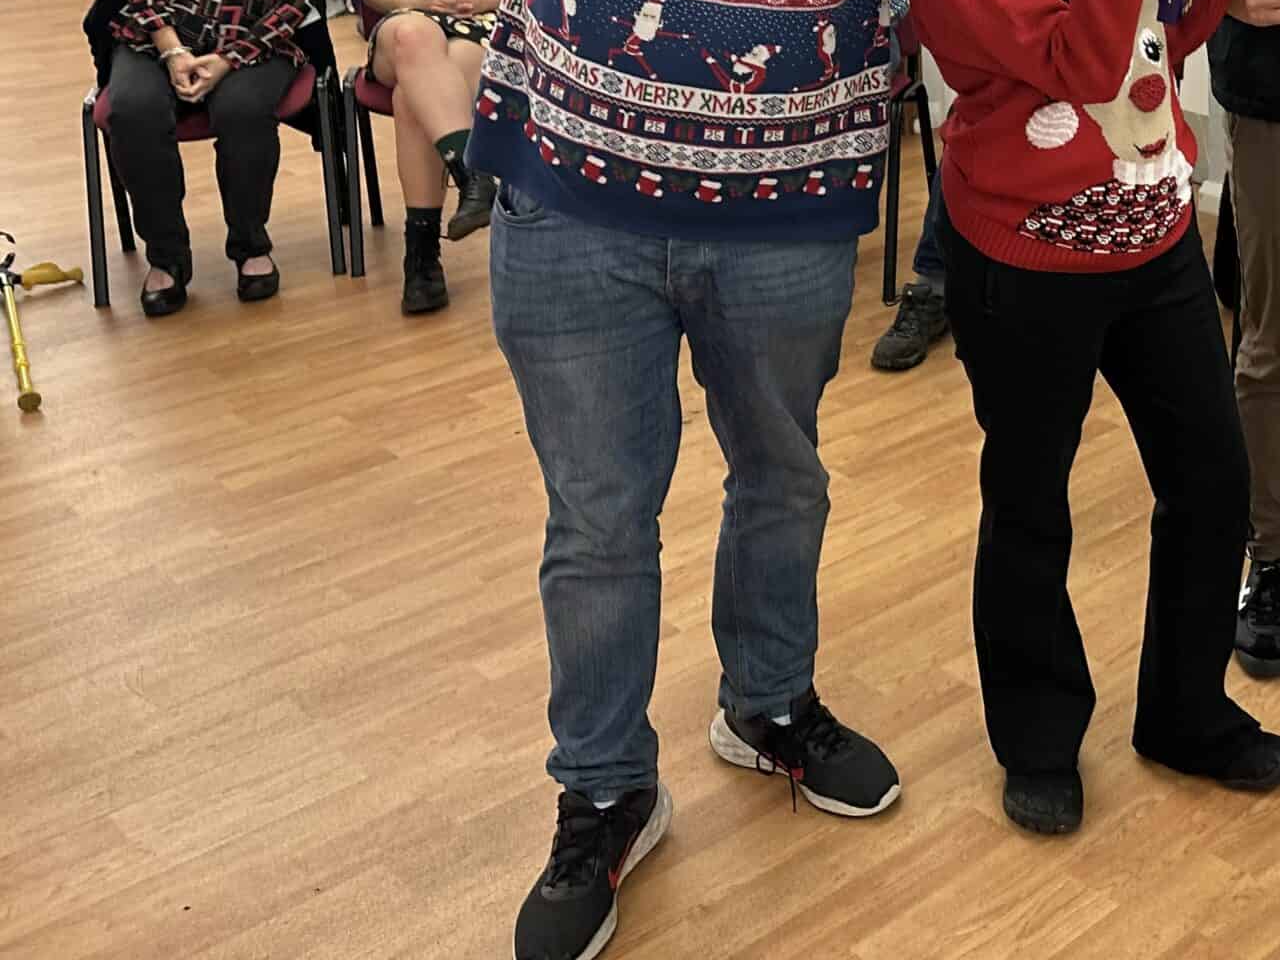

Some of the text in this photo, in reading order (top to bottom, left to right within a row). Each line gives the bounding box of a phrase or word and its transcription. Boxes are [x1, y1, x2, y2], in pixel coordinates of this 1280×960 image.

[560, 51, 599, 86] XMAS
[624, 78, 695, 108] MERRY
[700, 94, 757, 114] XMAS
[788, 82, 841, 112] MERRY
[843, 70, 881, 100] XMAS
